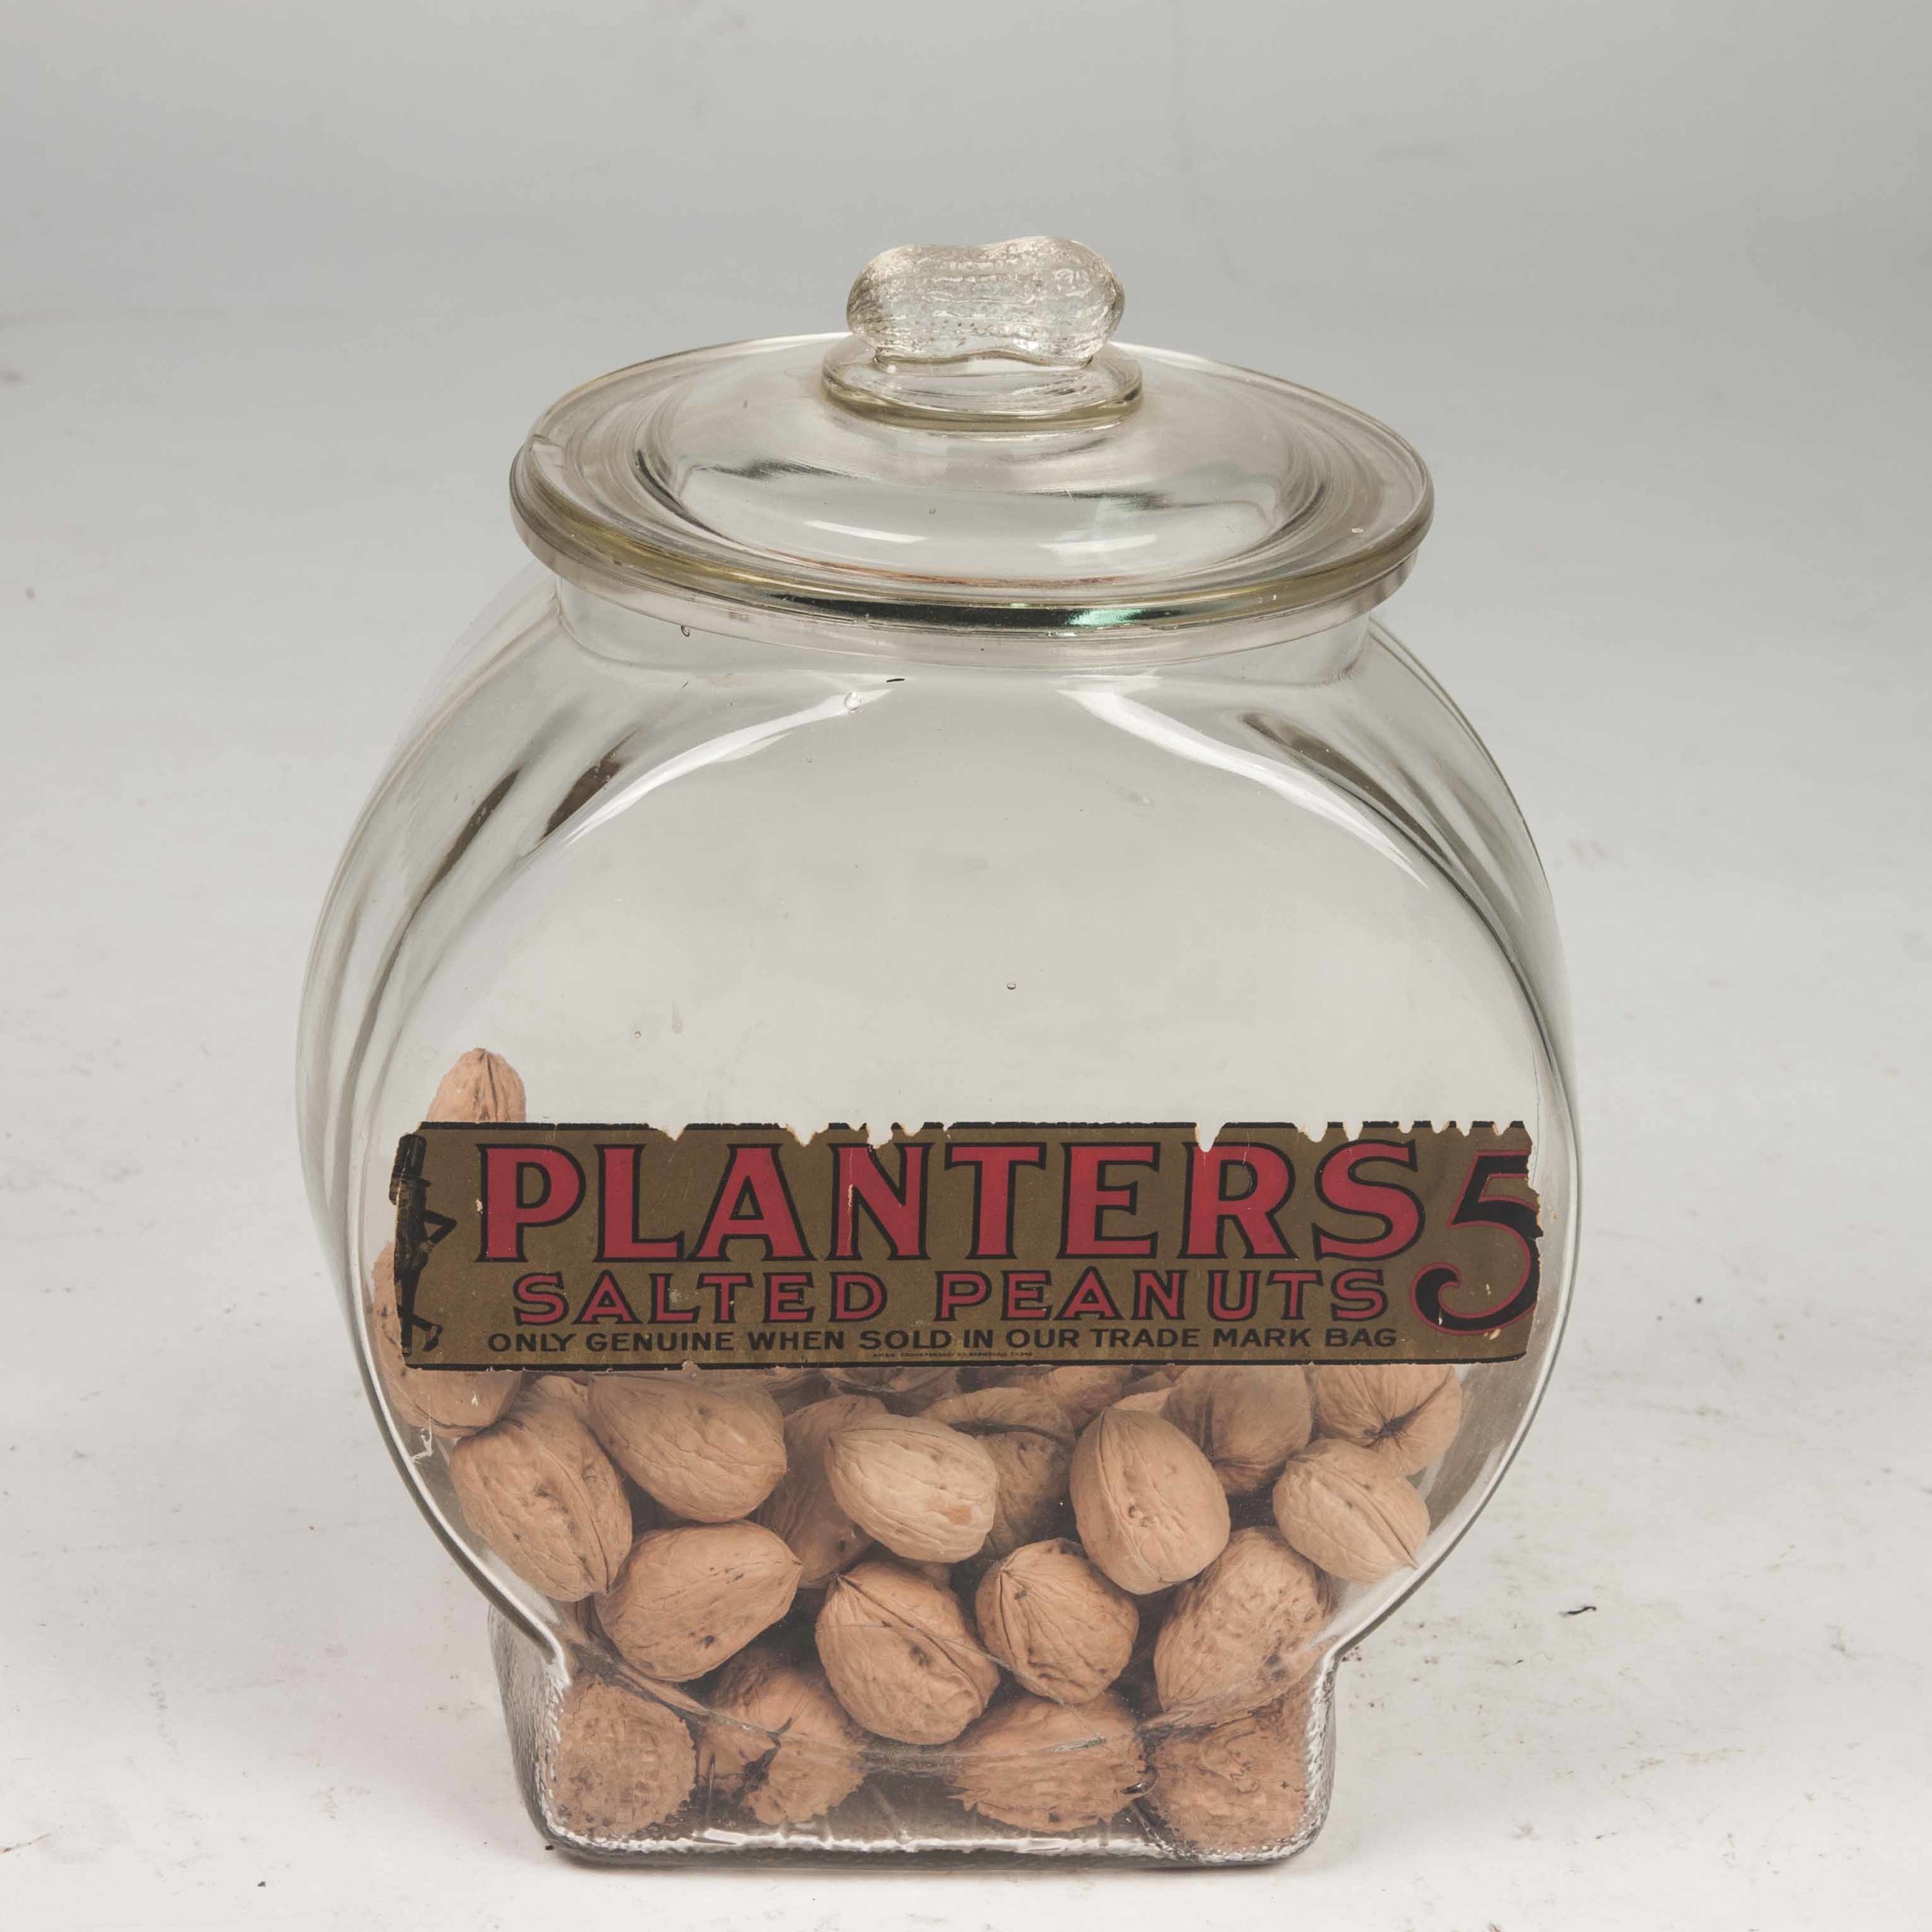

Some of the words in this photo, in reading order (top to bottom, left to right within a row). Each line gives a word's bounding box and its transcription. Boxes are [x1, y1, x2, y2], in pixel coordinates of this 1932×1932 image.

[475, 1140, 1426, 1262] PLANTERS
[1408, 1149, 1541, 1335] 5
[488, 1332, 577, 1352] ONLY
[586, 1332, 734, 1352] GENUINE
[747, 1330, 845, 1350] WHEN
[859, 1328, 952, 1350] SOLD
[963, 1328, 994, 1349] IN
[1005, 1328, 1080, 1348] OUR
[1090, 1328, 1200, 1347] TRADE
[1213, 1328, 1311, 1347] MARK
[1325, 1328, 1397, 1347] BAG
[512, 1270, 887, 1325] SALTED
[934, 1266, 1388, 1322] PEANUTS
